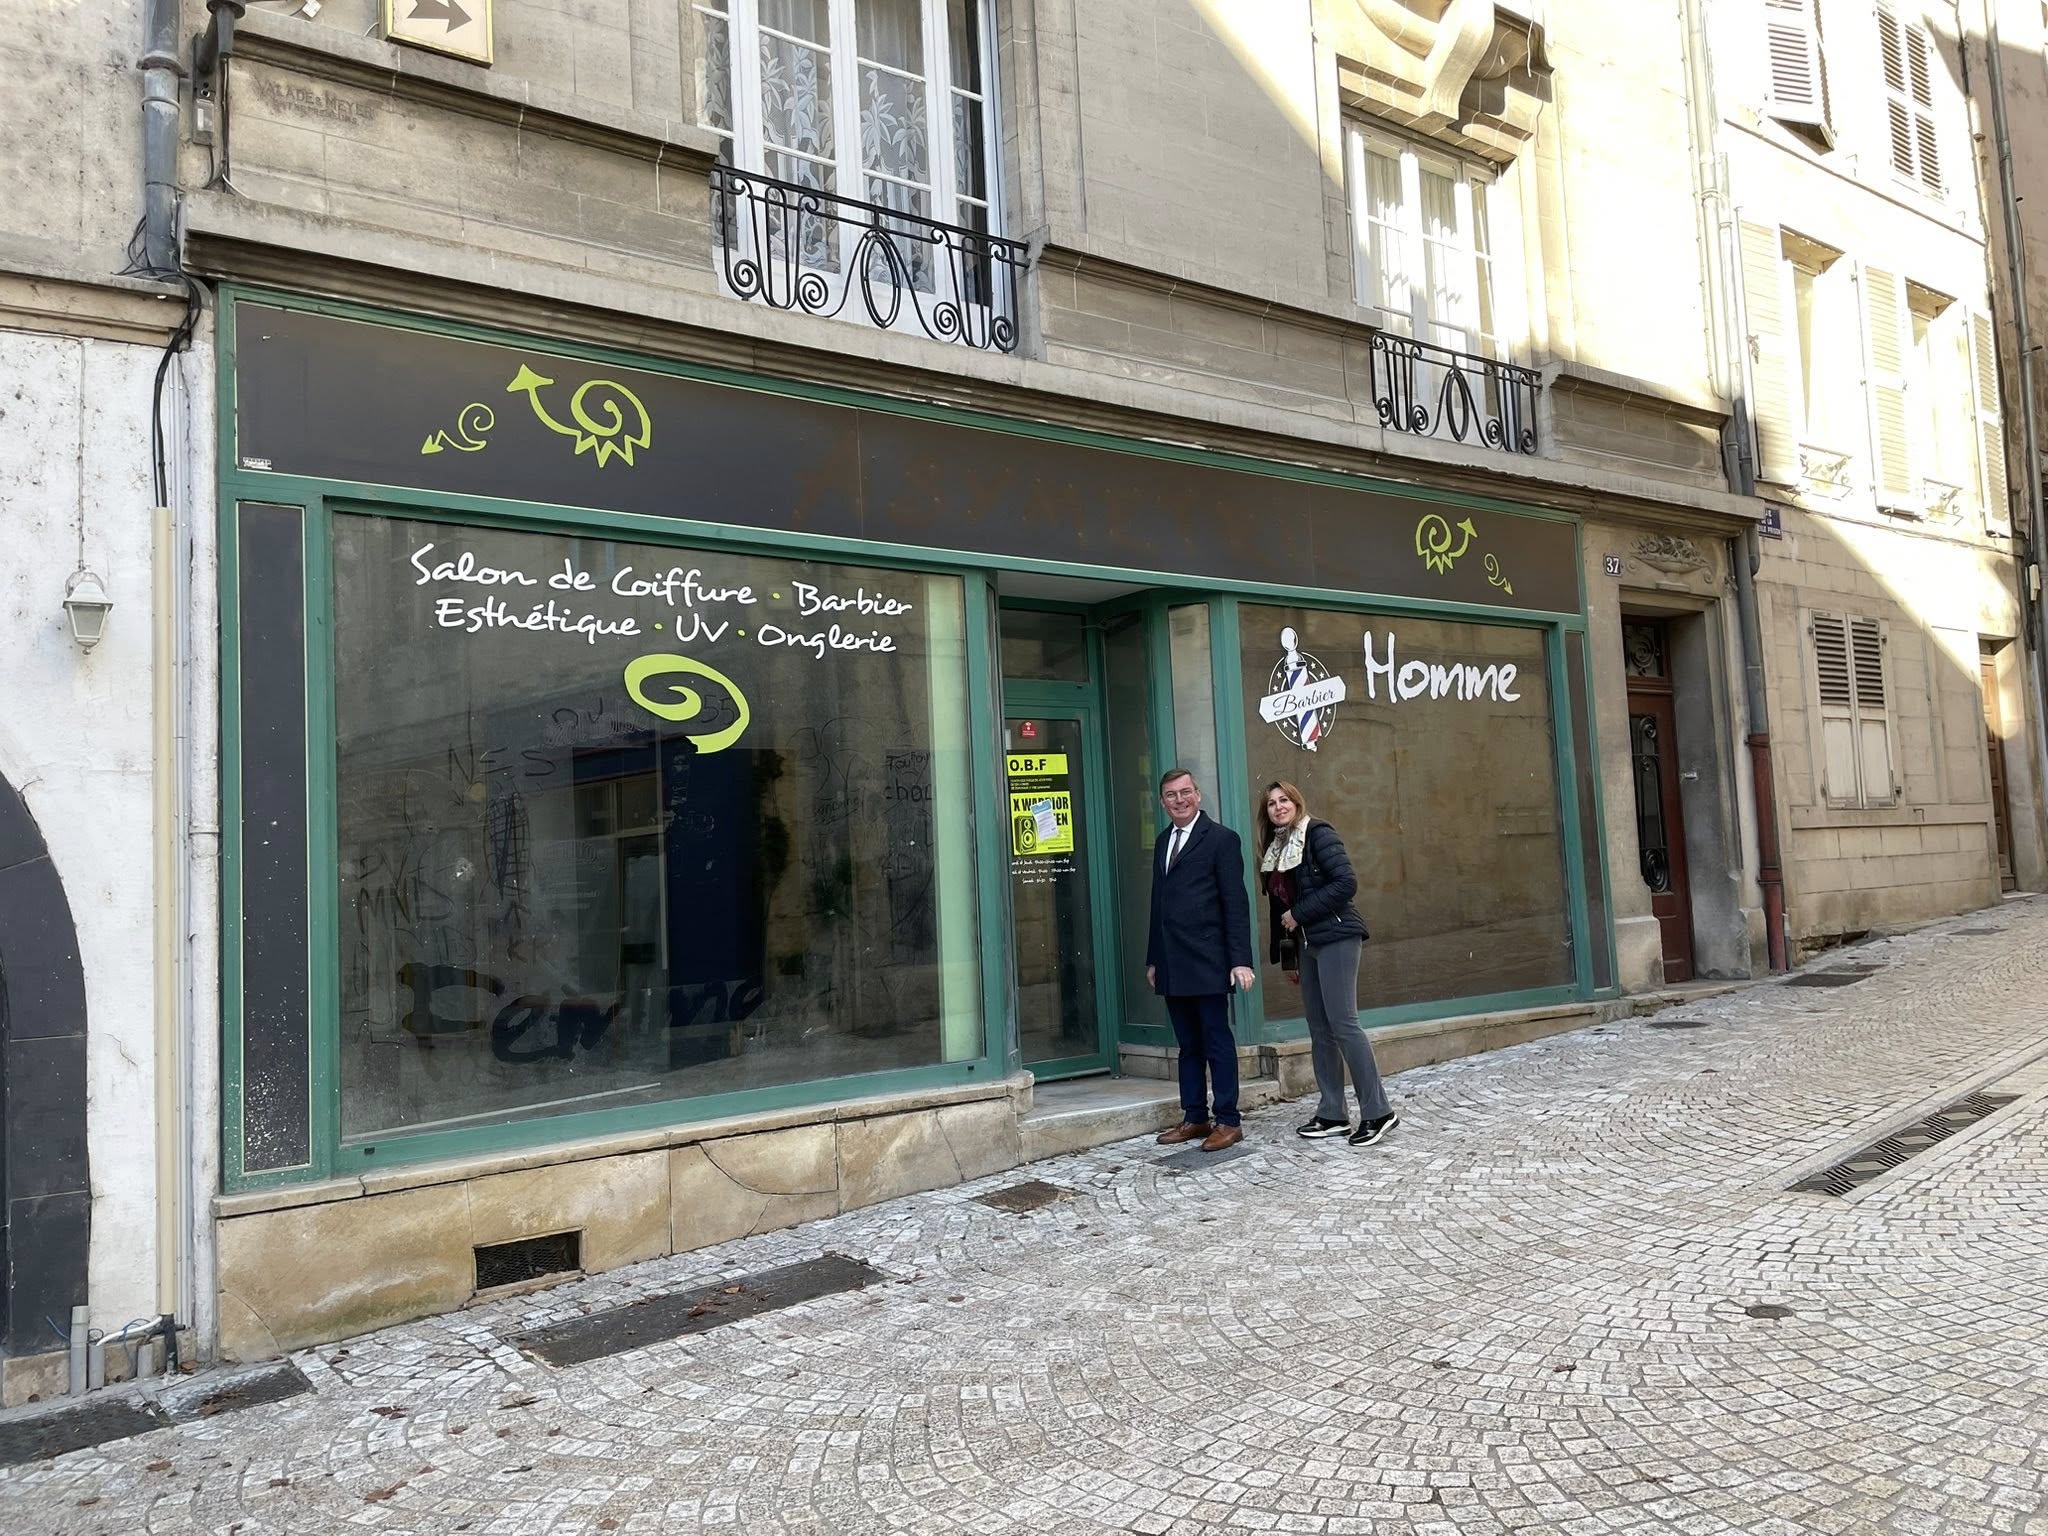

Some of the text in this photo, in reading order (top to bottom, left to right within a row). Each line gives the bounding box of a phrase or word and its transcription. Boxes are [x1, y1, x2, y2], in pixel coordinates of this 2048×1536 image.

[325, 89, 376, 121] MEYER
[411, 543, 913, 616] Salon de Coiffure Barbier
[1606, 557, 1620, 573] 37
[434, 595, 897, 660] Esthétique UV Onglerie
[1363, 630, 1521, 704] Homme
[1272, 688, 1337, 717] Barbier
[1009, 759, 1047, 772] O.B.F
[1013, 799, 1021, 812] X
